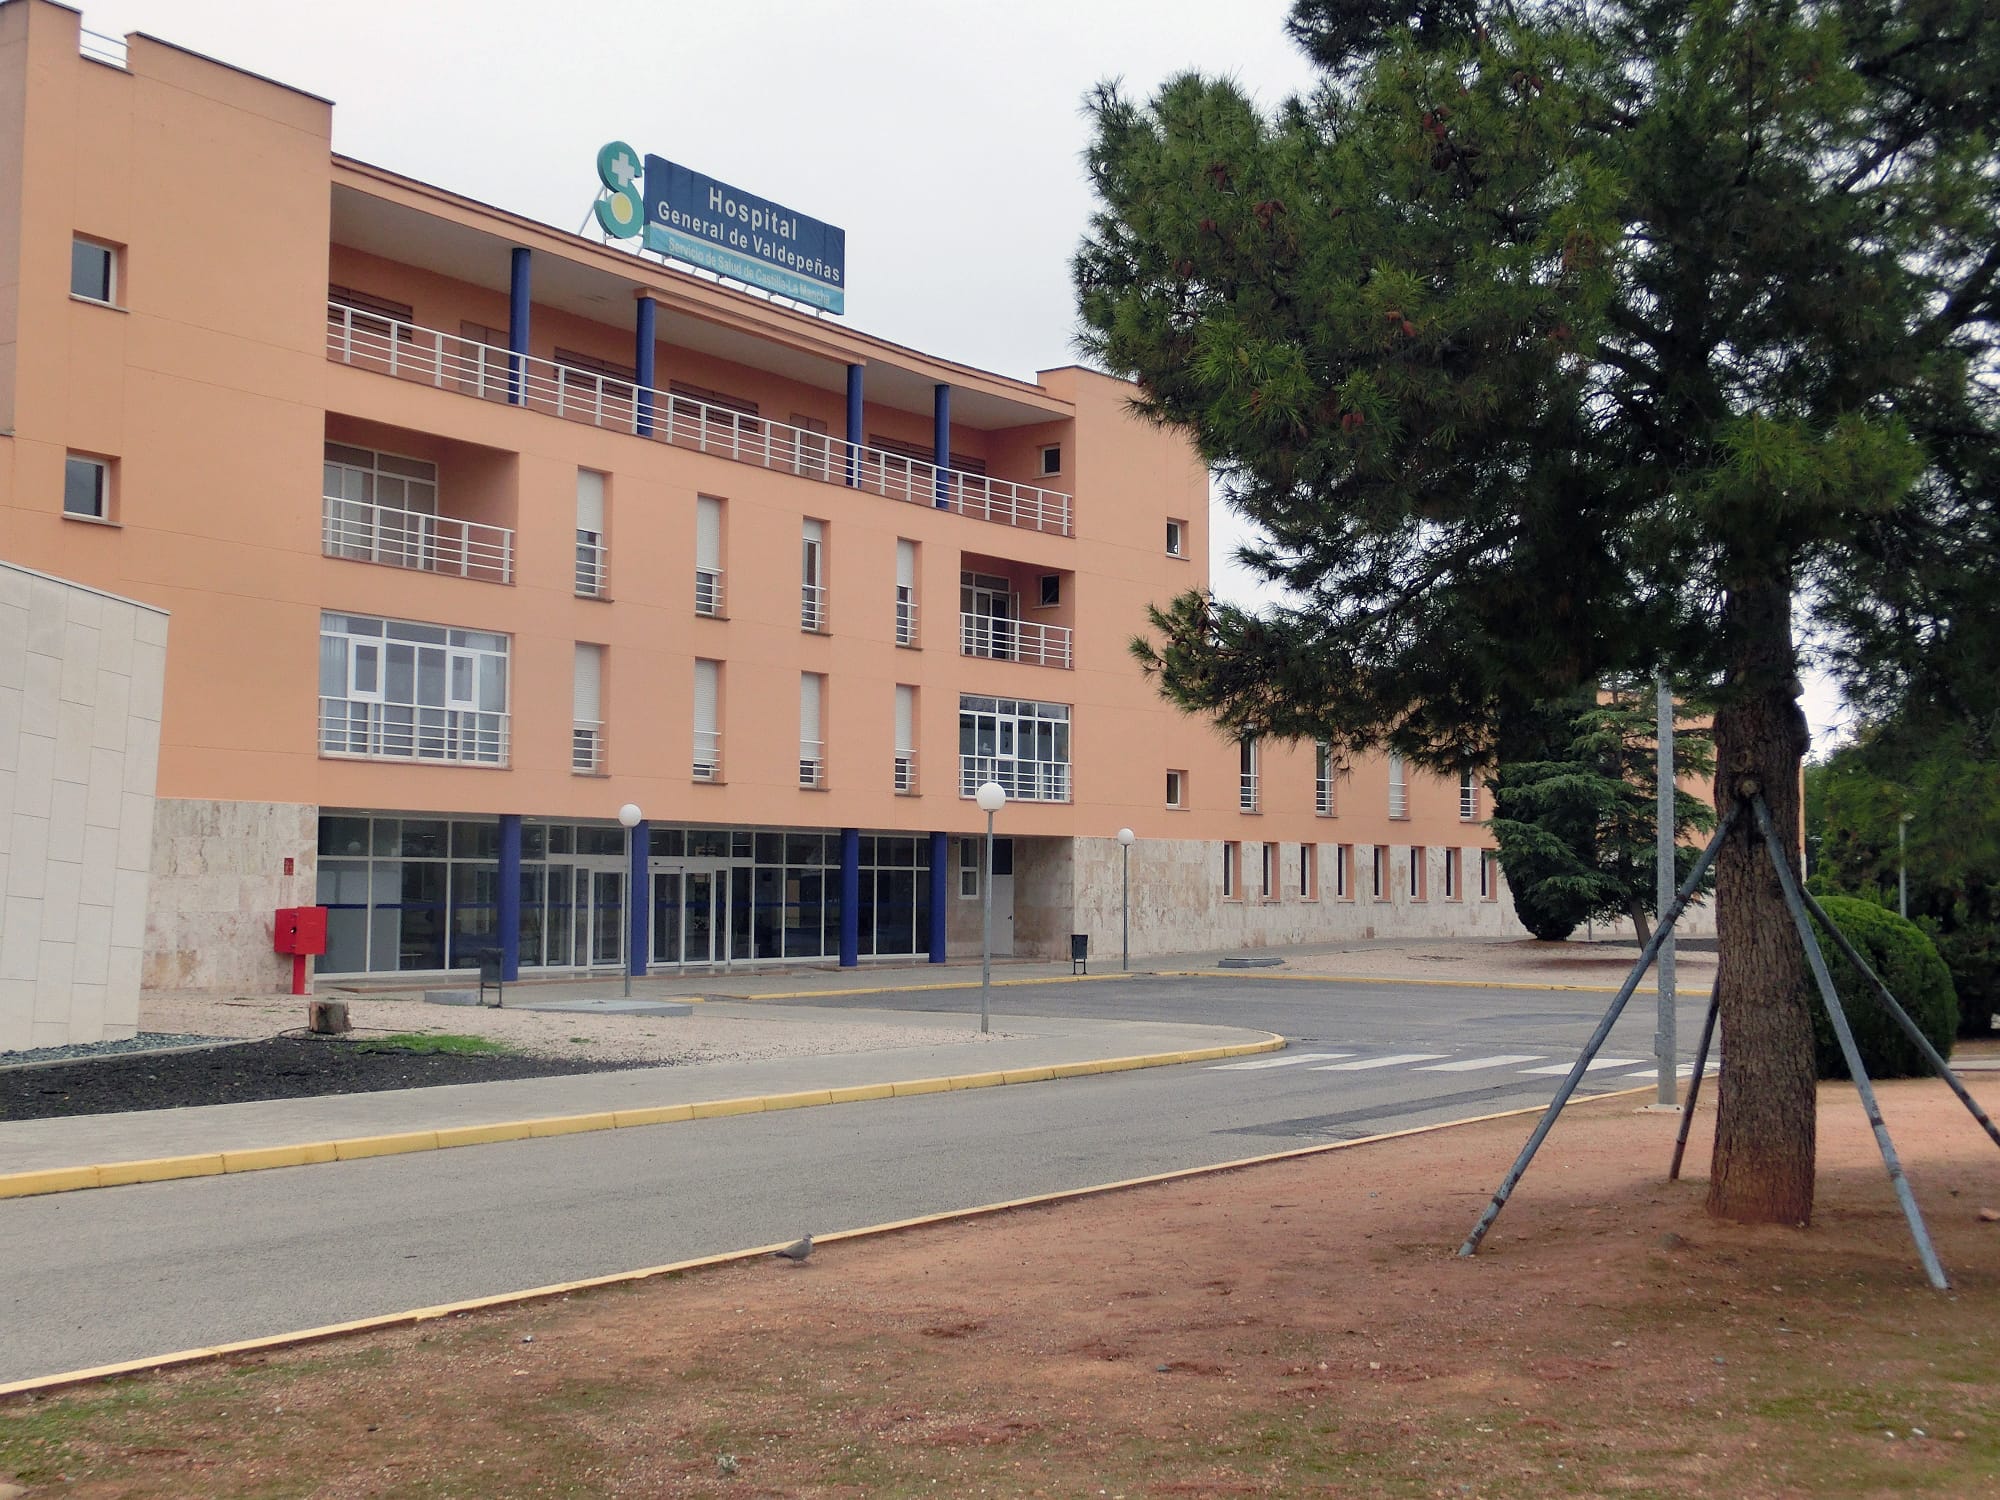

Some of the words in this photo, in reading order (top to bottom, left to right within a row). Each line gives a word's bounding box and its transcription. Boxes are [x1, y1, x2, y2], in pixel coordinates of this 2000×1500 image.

[709, 186, 797, 240] Hospital
[658, 201, 723, 240] General
[729, 228, 748, 248] de
[753, 234, 840, 281] Valdepeñas
[669, 236, 704, 262] Servicio
[706, 251, 716, 266] de
[719, 255, 743, 275] Salud
[744, 264, 754, 279] de
